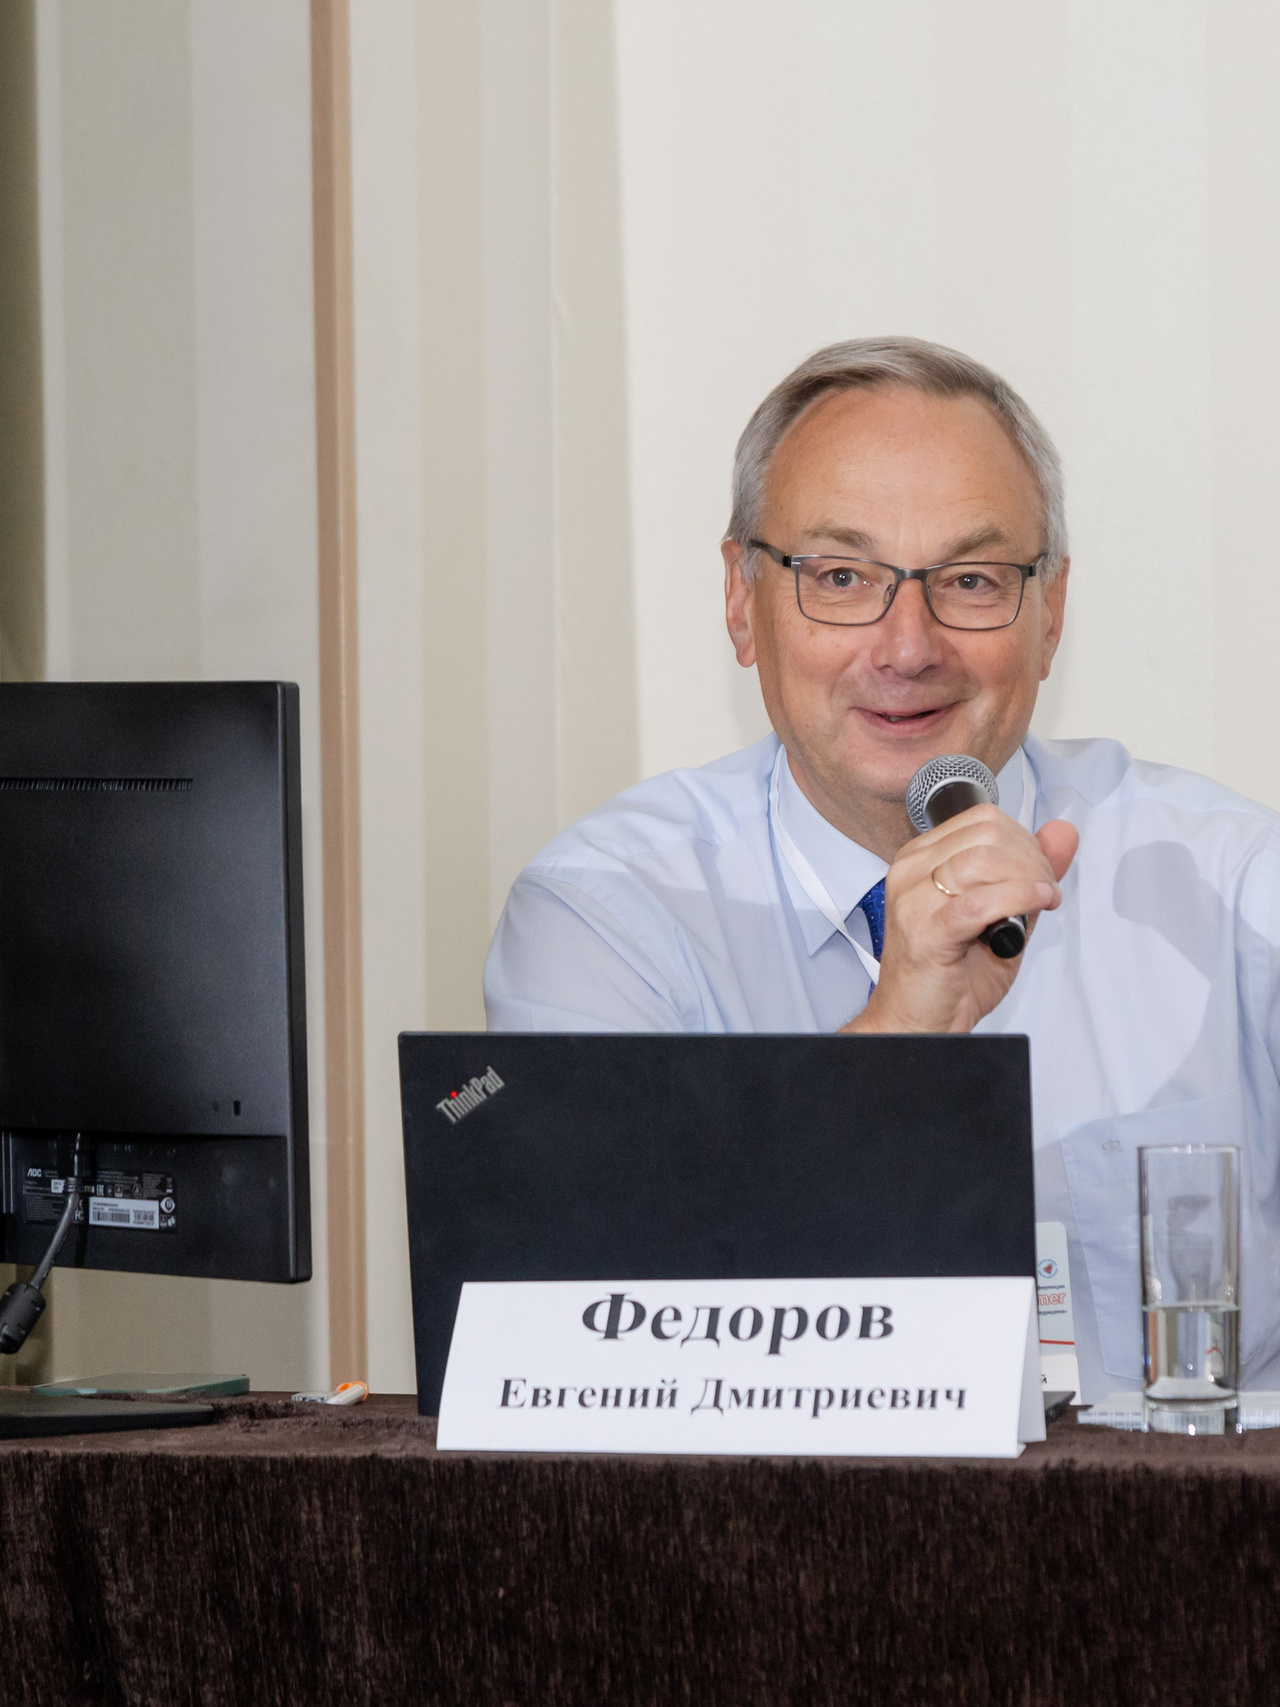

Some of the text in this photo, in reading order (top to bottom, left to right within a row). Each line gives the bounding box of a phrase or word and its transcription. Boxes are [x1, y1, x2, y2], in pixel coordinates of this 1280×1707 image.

[436, 1065, 505, 1123] ThinkPad
[27, 1168, 42, 1178] AOC
[581, 1292, 895, 1356] Федоров
[499, 1377, 967, 1419] Евгений Дмитриевич
